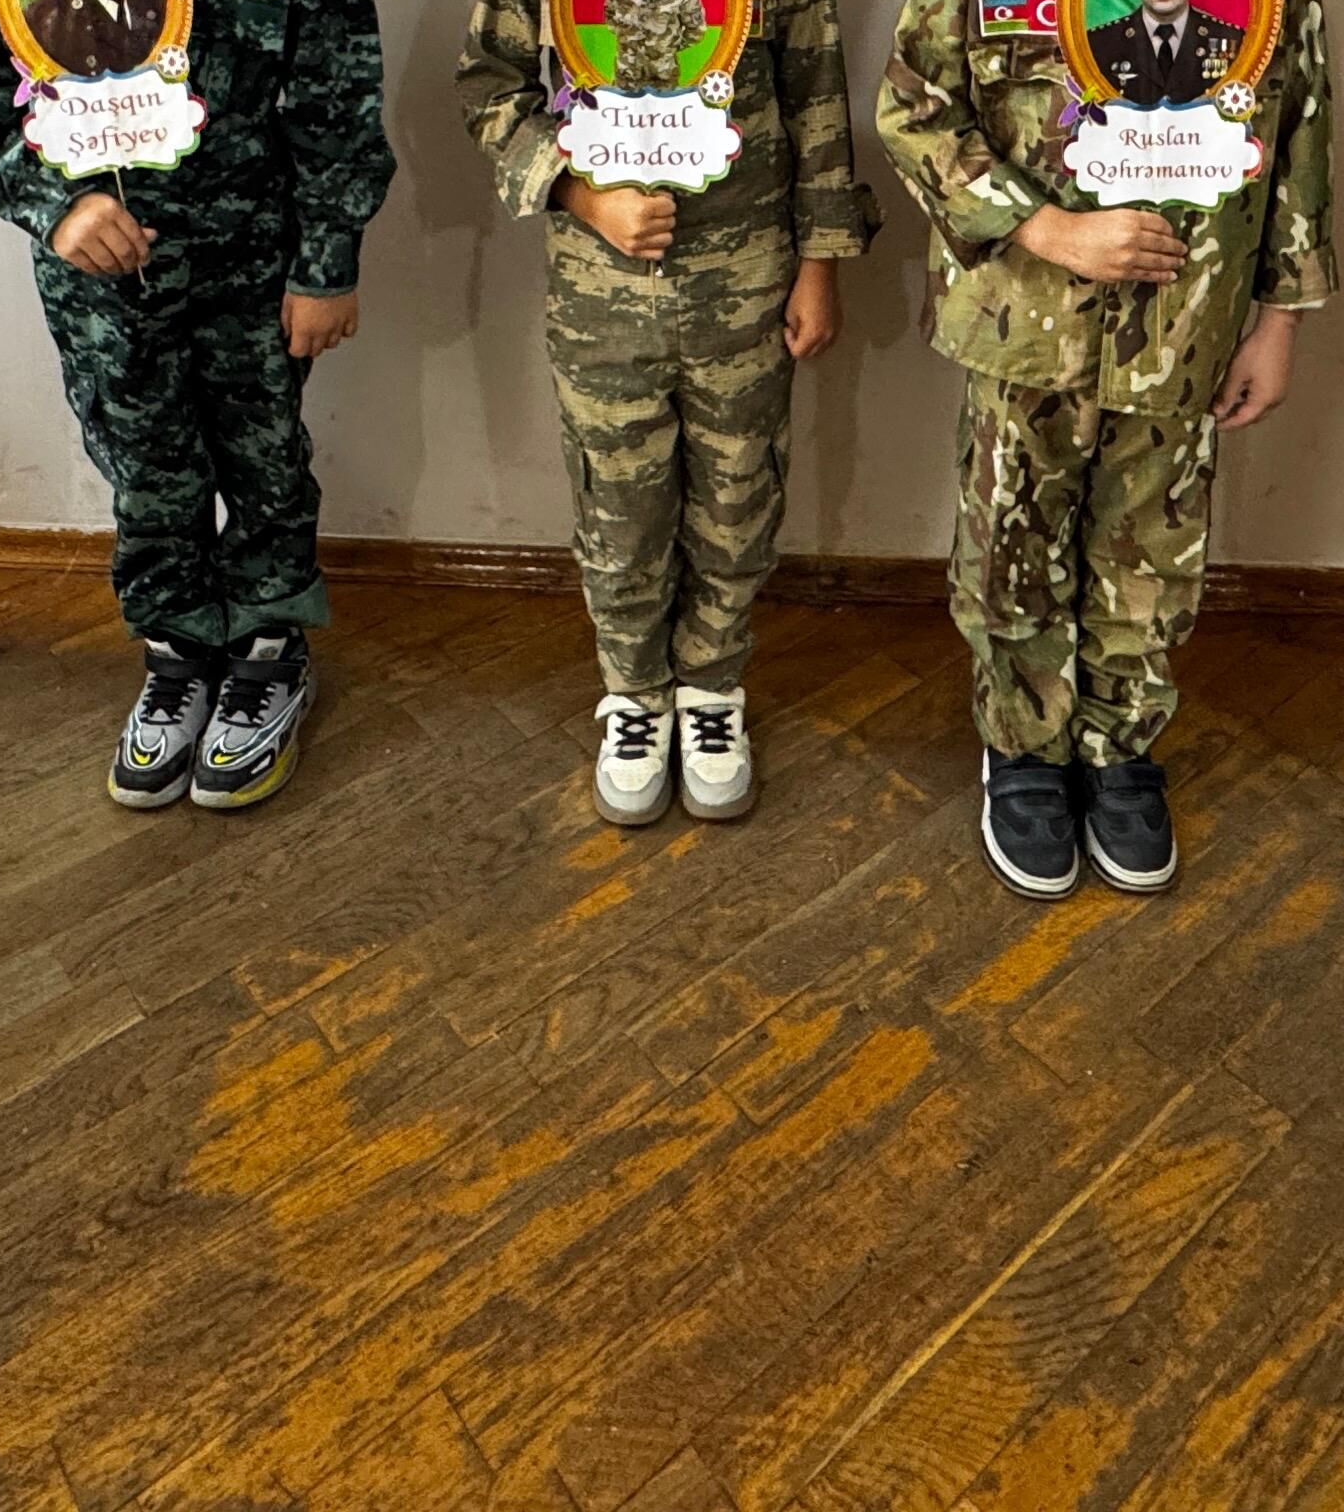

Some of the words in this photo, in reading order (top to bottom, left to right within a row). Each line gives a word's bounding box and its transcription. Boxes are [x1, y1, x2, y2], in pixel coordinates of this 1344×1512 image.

[60, 90, 164, 118] Daşqın
[601, 105, 694, 129] Tural
[69, 126, 169, 159] Şəfiyev
[1119, 126, 1202, 149] Ruslan
[588, 143, 705, 167] Əhədov
[1087, 159, 1232, 187] Qəhrəmanov
